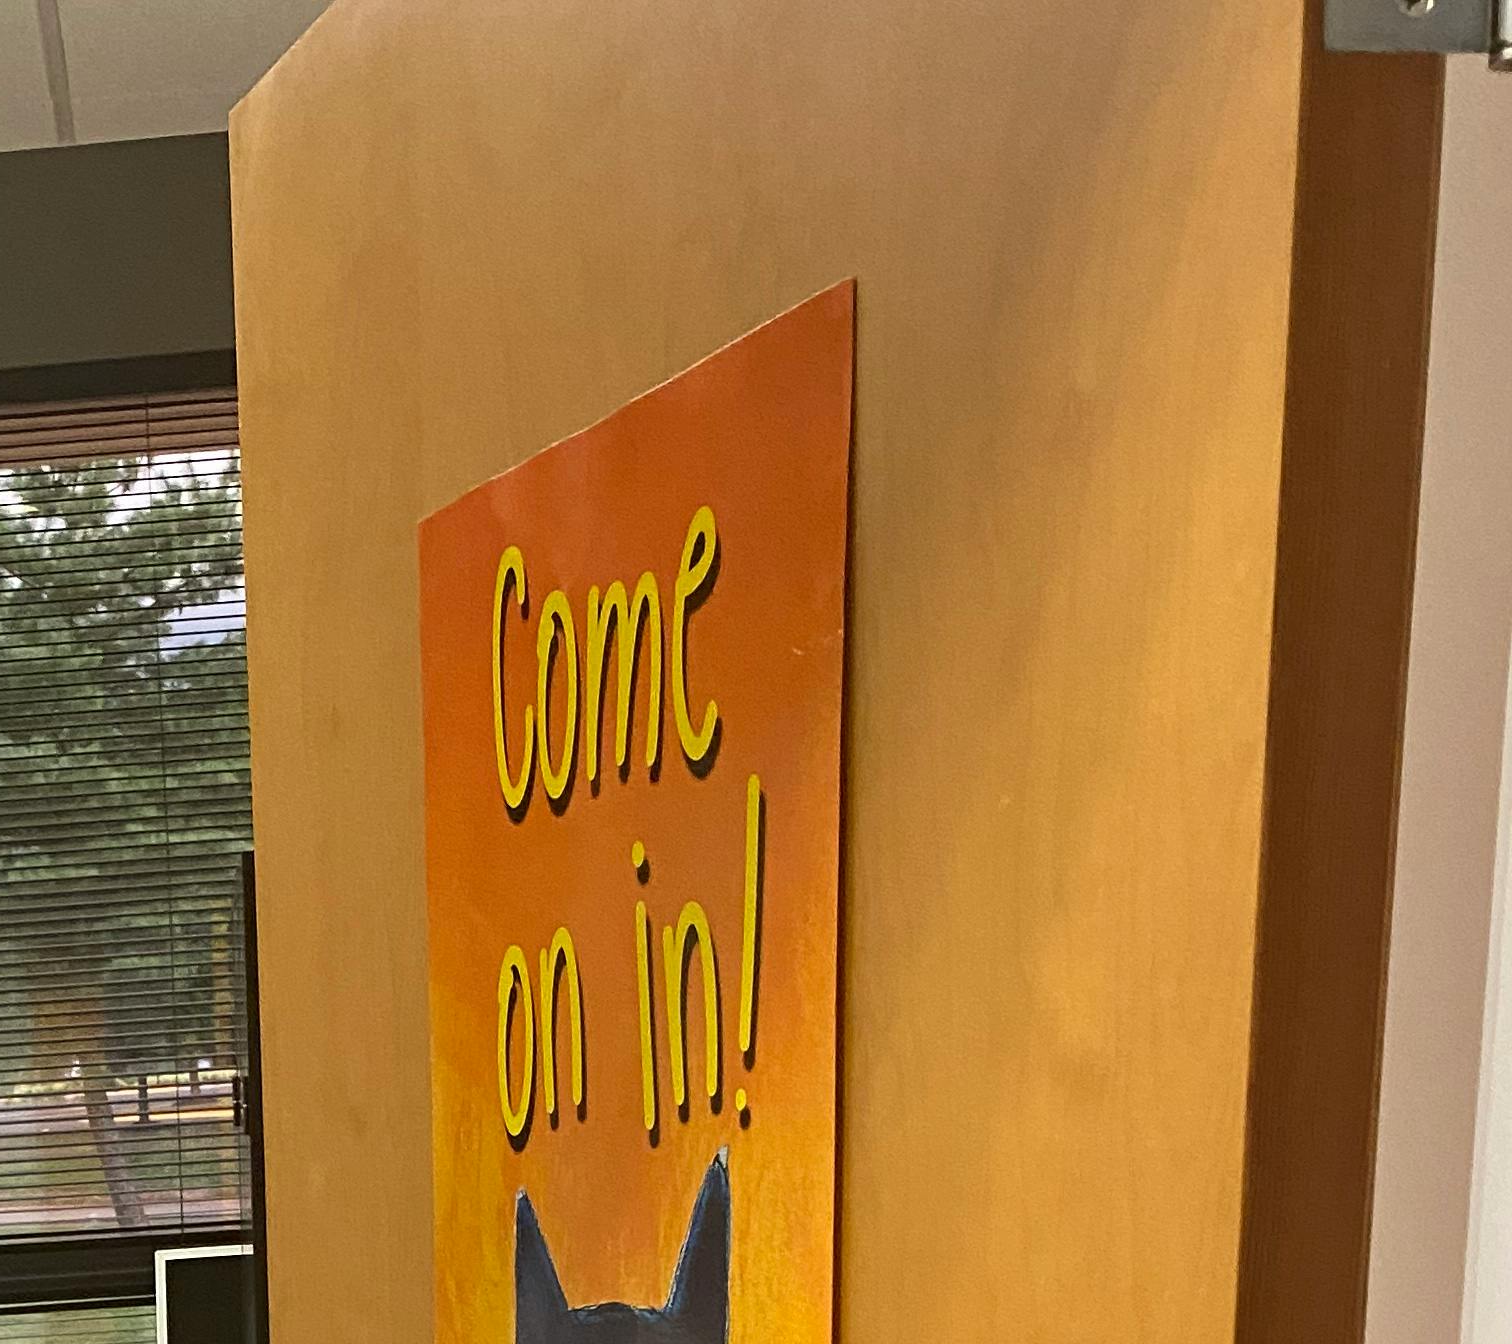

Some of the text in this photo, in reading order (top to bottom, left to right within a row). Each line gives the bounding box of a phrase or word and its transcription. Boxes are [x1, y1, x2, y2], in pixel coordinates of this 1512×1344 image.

[492, 505, 719, 812] Come
[497, 773, 761, 1137] on in!
